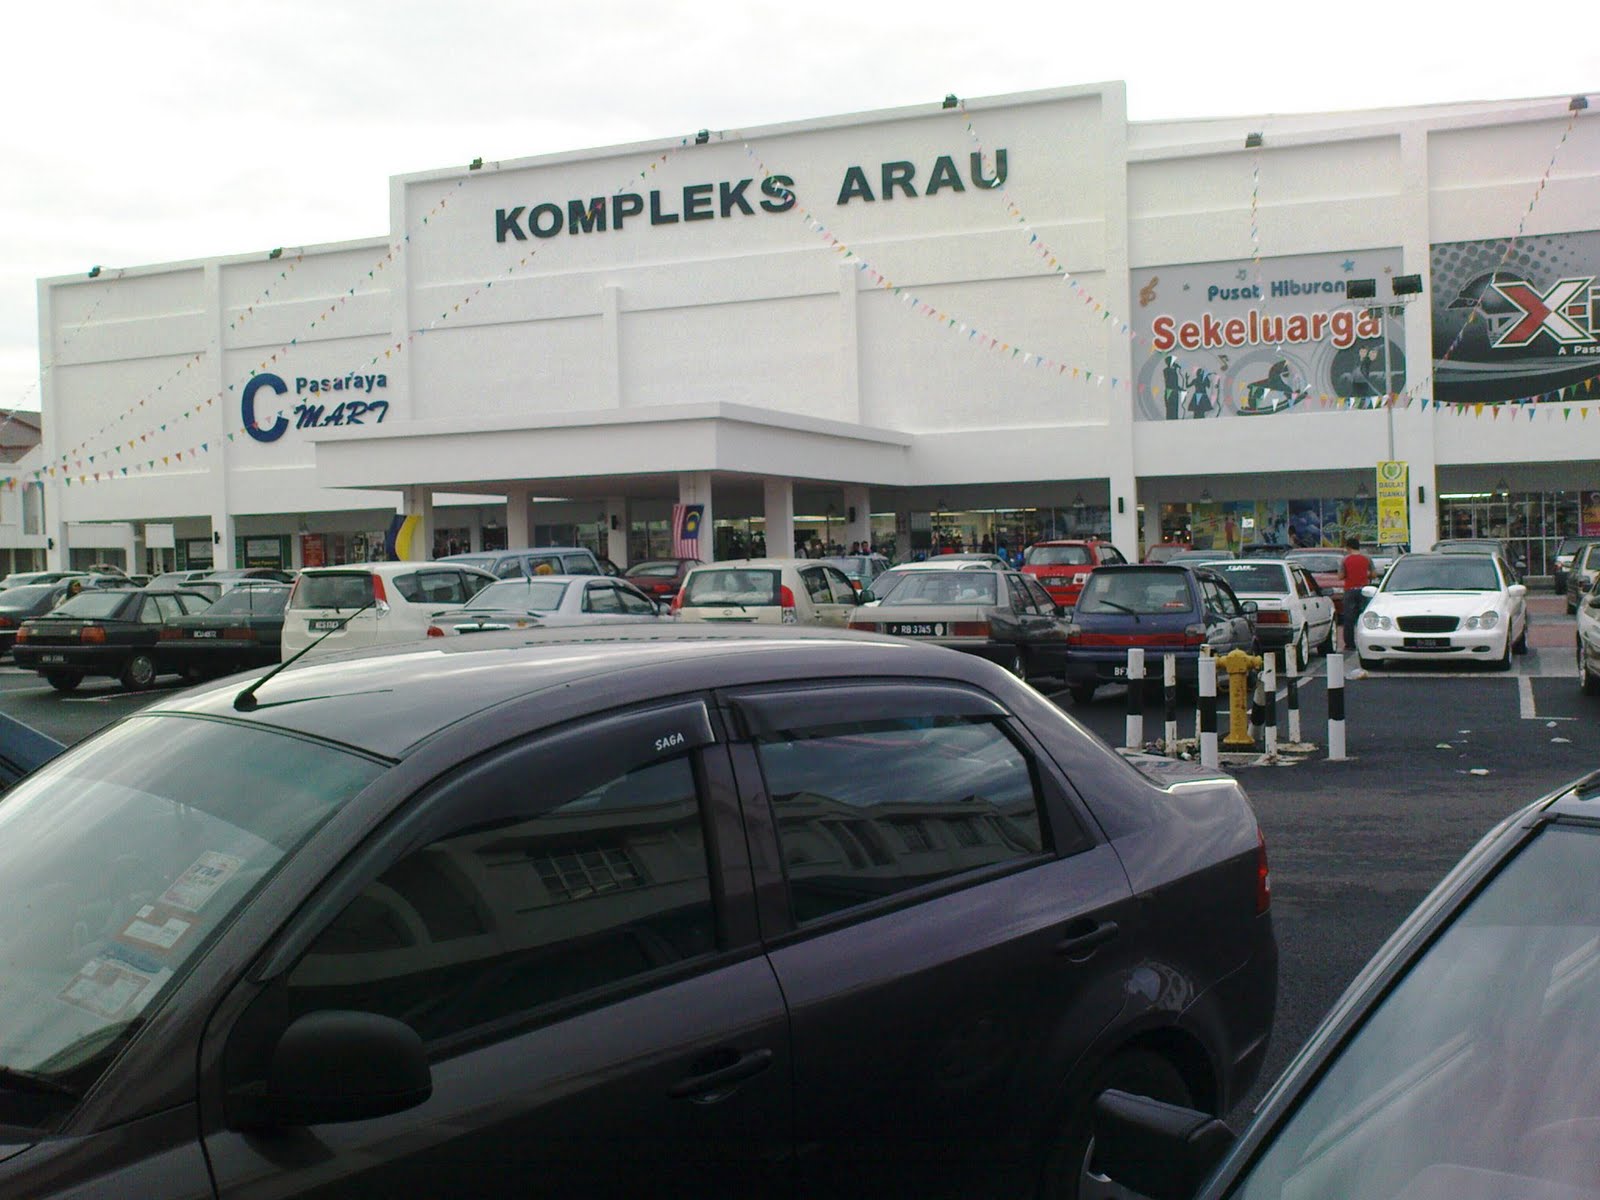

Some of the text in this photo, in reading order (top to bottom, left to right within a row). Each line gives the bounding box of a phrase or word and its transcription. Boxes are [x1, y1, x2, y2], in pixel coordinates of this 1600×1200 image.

[495, 149, 1008, 243] KOMPLEKS ARAU
[1207, 280, 1345, 301] Pusat Hiburan
[1152, 309, 1383, 350] Sekeluarga
[1558, 346, 1567, 355] A
[295, 374, 388, 394] Pasaraya
[241, 373, 289, 443] C
[294, 400, 389, 430] MART
[655, 732, 685, 751] SAGA
